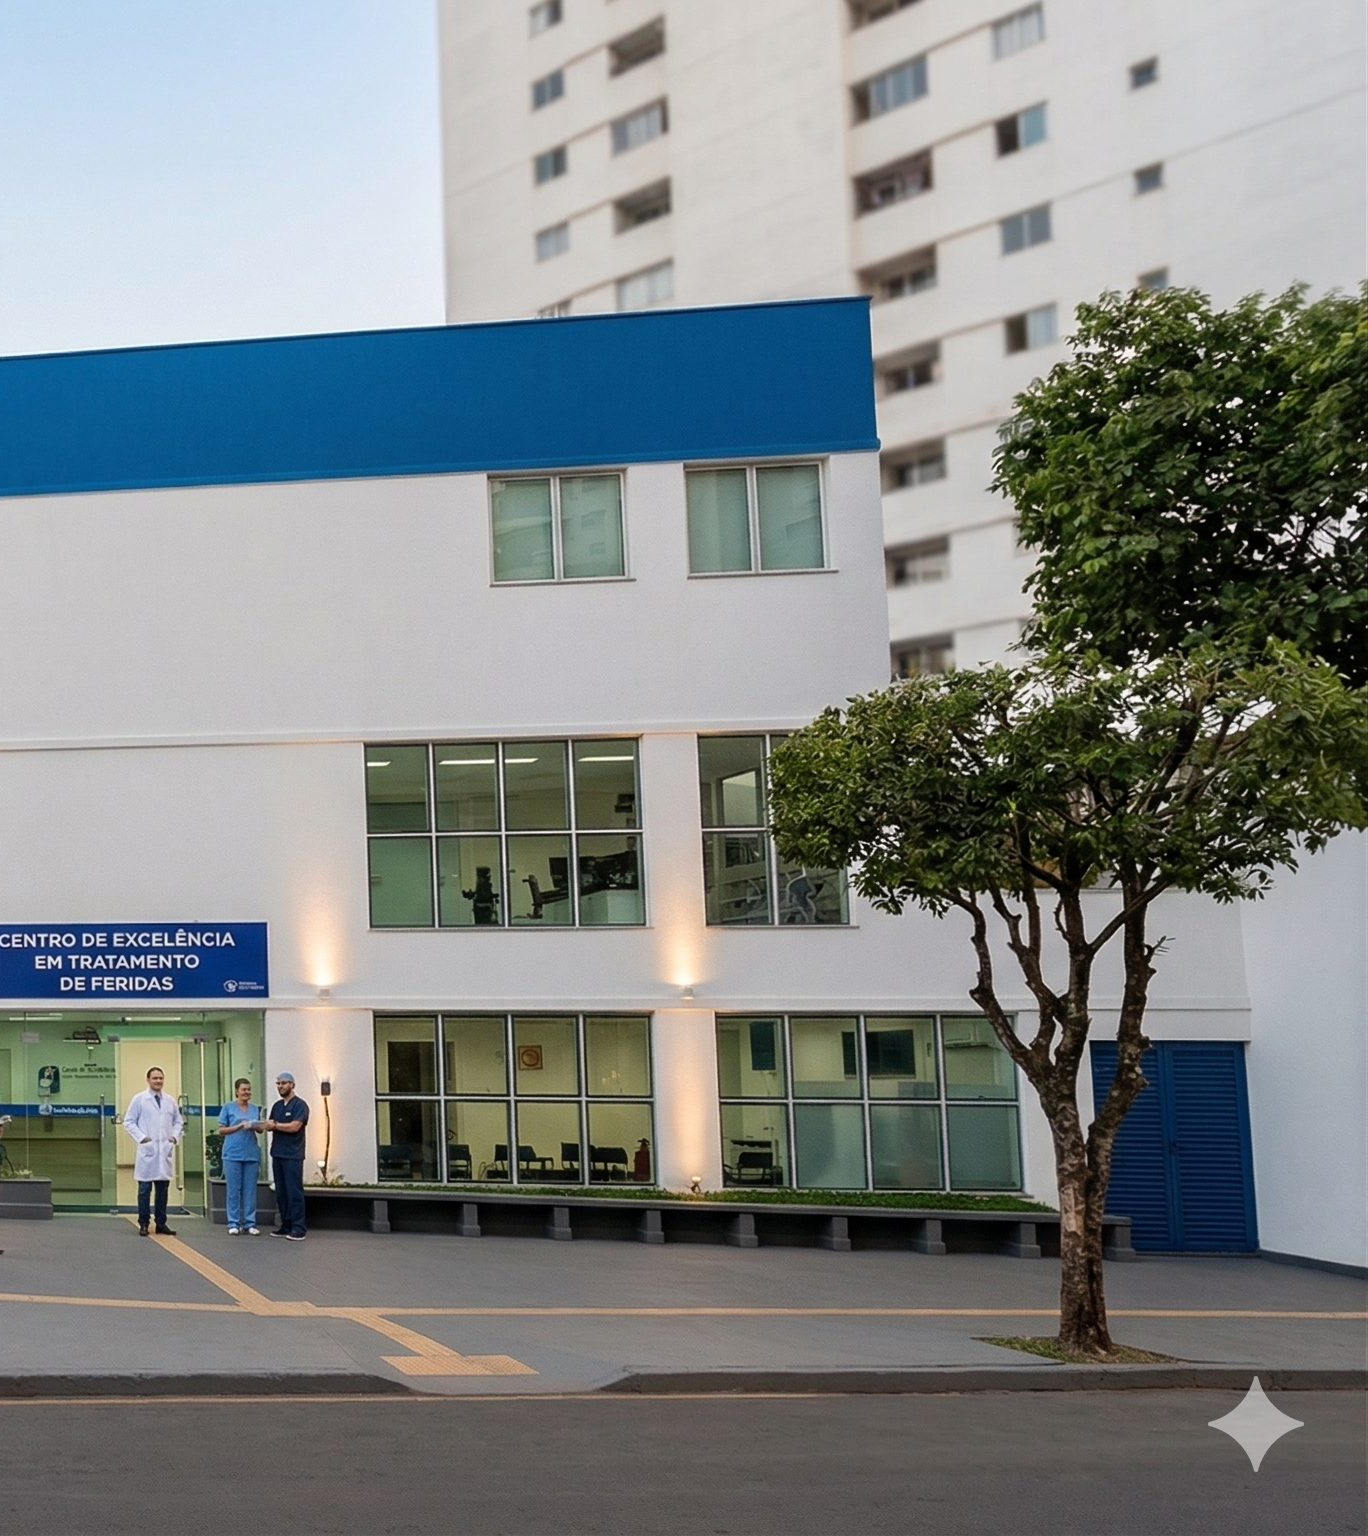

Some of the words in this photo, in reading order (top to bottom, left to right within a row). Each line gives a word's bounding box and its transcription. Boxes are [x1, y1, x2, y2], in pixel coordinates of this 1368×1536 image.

[82, 933, 108, 948] DE
[112, 928, 236, 948] EXCELÊNCIA
[34, 955, 63, 970] EM
[68, 954, 200, 970] TRATAMENTO
[60, 977, 86, 991] DE
[91, 976, 175, 991] FERIDAS
